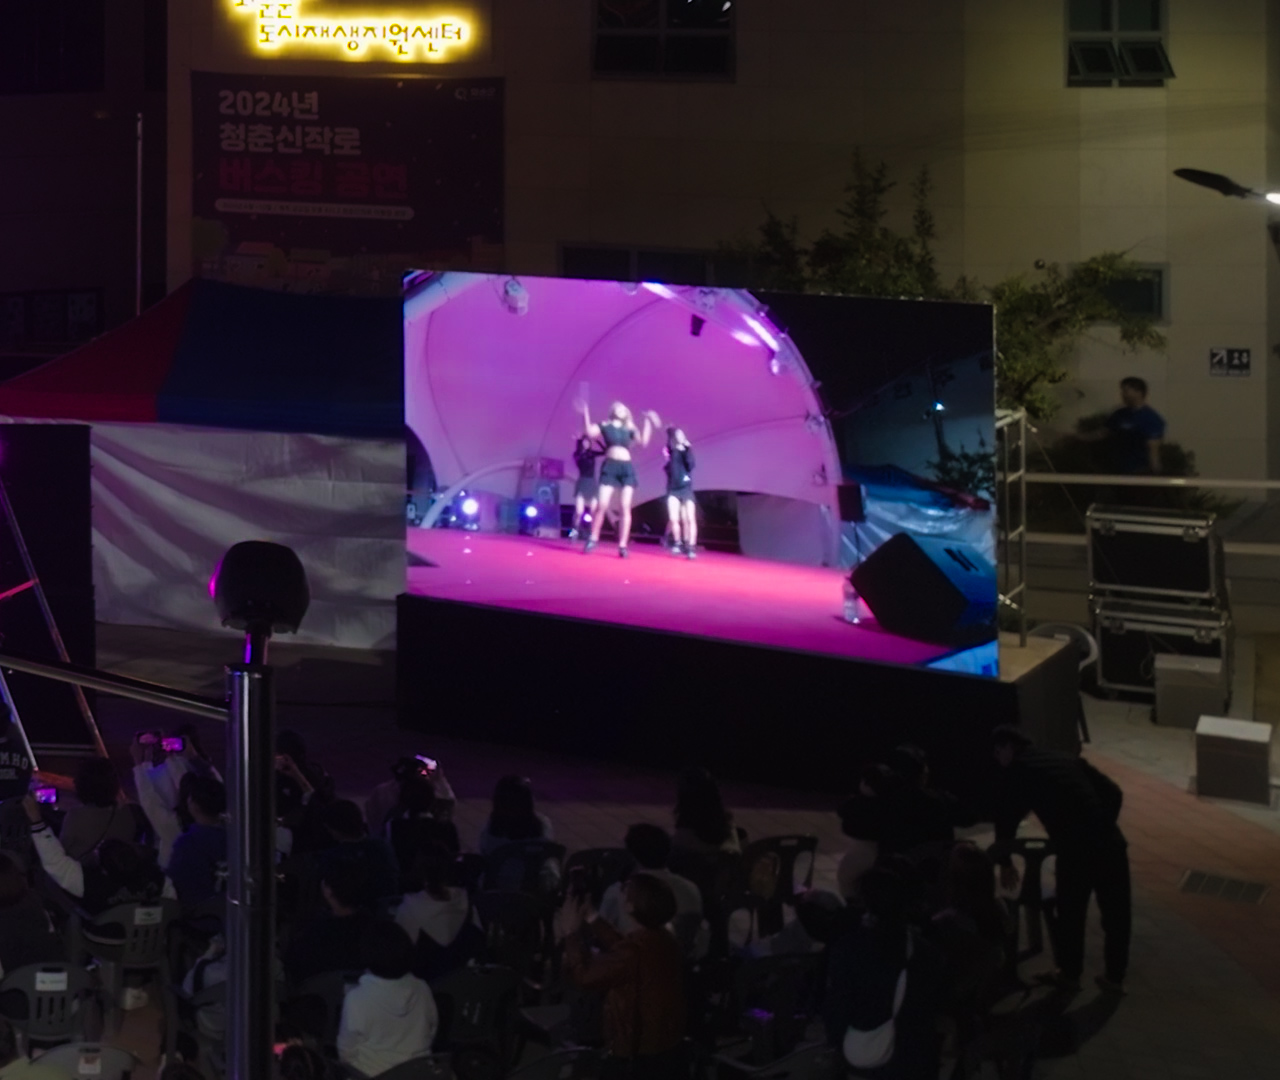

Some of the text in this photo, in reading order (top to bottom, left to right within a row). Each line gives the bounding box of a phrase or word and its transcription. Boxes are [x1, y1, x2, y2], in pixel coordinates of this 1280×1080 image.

[259, 23, 462, 55] 도시재생지원센터
[218, 89, 320, 120] 2024년
[218, 122, 362, 156] 청춘신작로
[218, 157, 408, 200] 버스킹 공연
